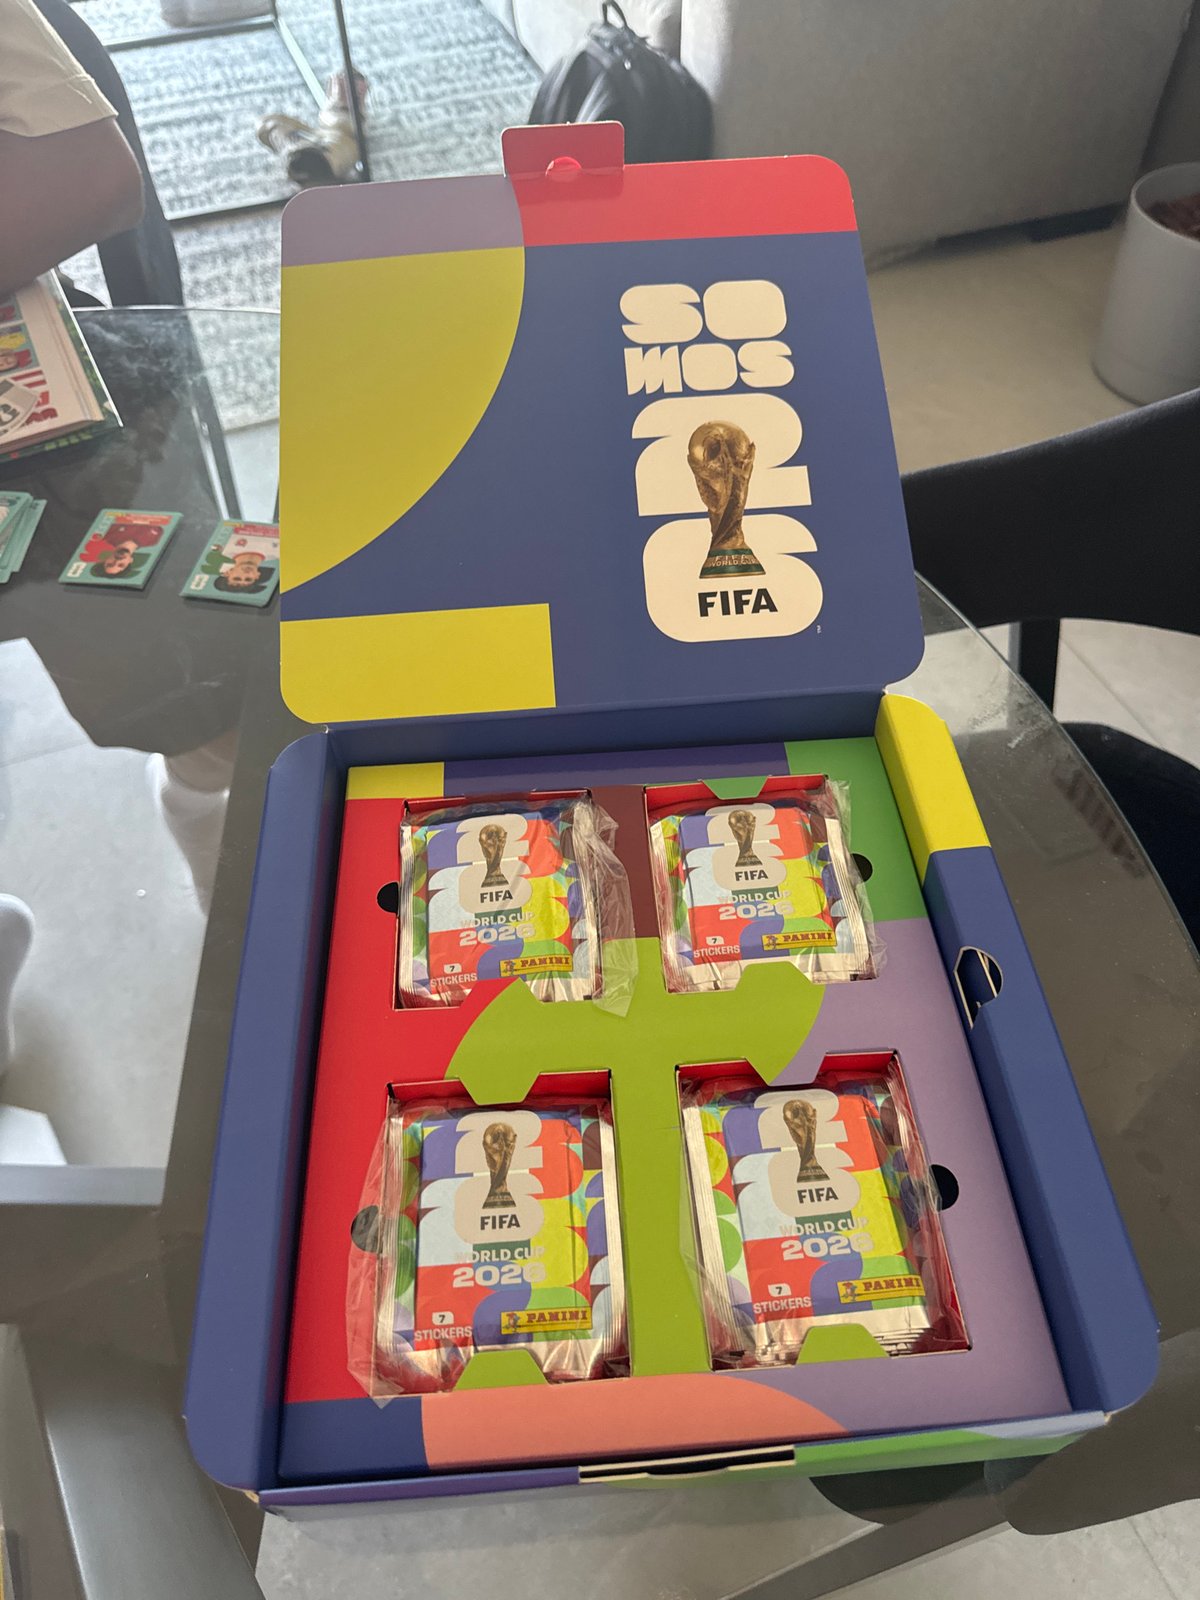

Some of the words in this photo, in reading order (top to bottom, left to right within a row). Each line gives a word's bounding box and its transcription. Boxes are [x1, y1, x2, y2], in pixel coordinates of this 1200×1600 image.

[697, 587, 778, 617] FIFA
[735, 869, 768, 881] FIFA
[480, 890, 513, 903] FIFA
[766, 890, 791, 900] CUP
[719, 900, 794, 920] 2026
[509, 912, 534, 922] CUP
[459, 924, 536, 946] 2026
[783, 933, 832, 942] PANINI
[694, 945, 740, 958] STICKERS
[521, 957, 569, 967] PANINI
[430, 973, 477, 986] STICKERS
[797, 1187, 838, 1203] FIFA
[480, 1214, 520, 1230] FIFA
[838, 1217, 868, 1231] CUP
[514, 1247, 544, 1259] CUP
[781, 1232, 874, 1261] 2026
[453, 1262, 546, 1288] 2026
[863, 1278, 921, 1291] PANINI
[753, 1297, 811, 1314] STICKERS
[439, 1315, 445, 1323] 7
[527, 1310, 588, 1323] PANINI
[415, 1326, 472, 1341] STICKERS
